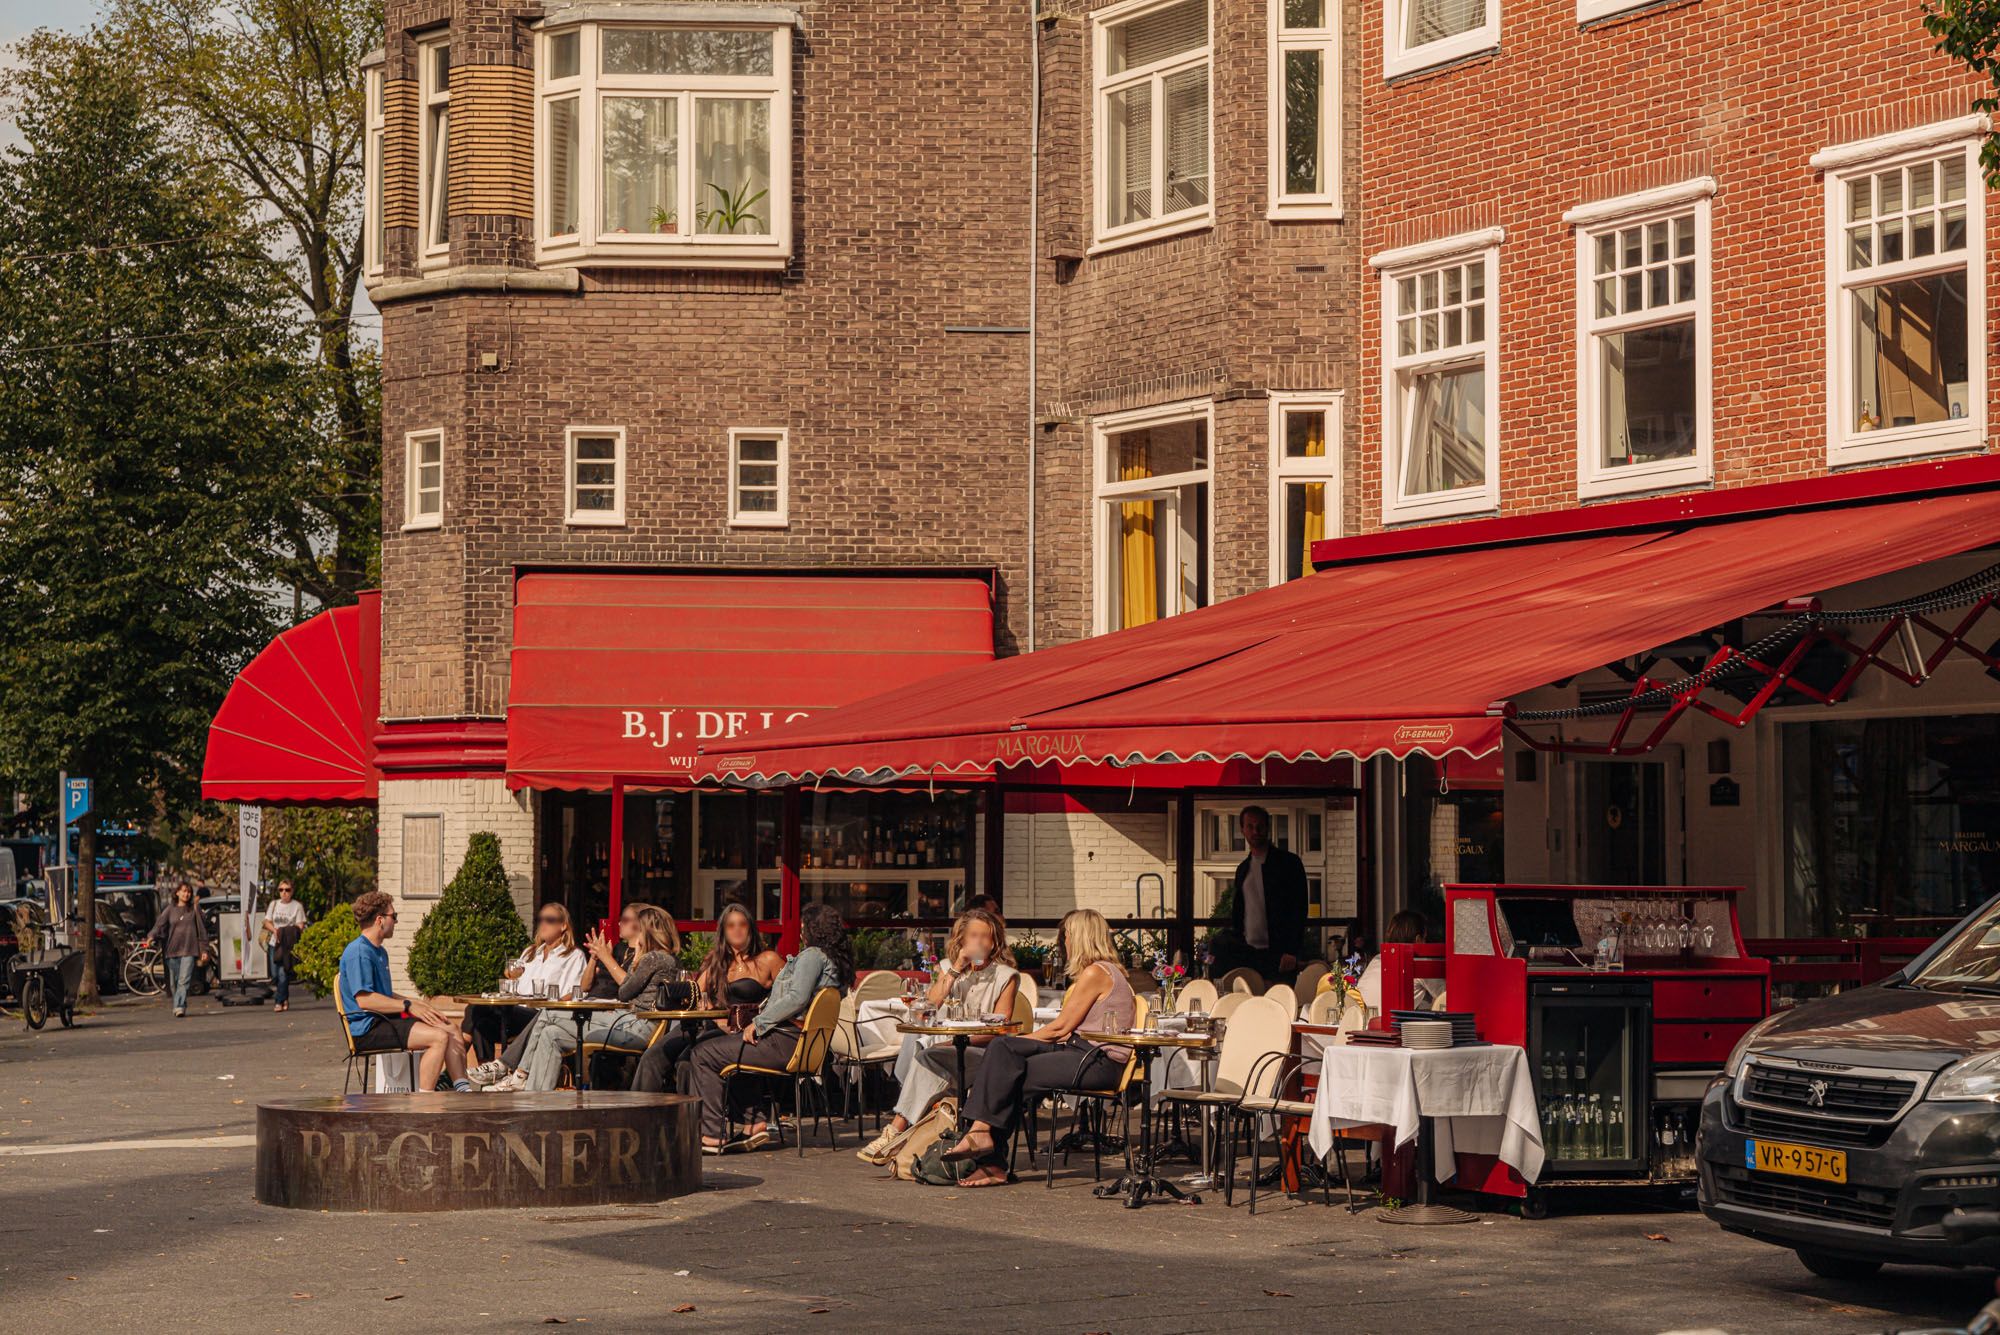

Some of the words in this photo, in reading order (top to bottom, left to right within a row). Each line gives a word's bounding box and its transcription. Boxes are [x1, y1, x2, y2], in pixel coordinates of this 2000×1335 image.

[622, 709, 683, 748] B.J.
[1400, 730, 1446, 739] ST-GERMAIN
[995, 735, 1086, 757] MARGAUX
[72, 790, 82, 809] P
[1761, 1145, 1840, 1177] VR-957-G
